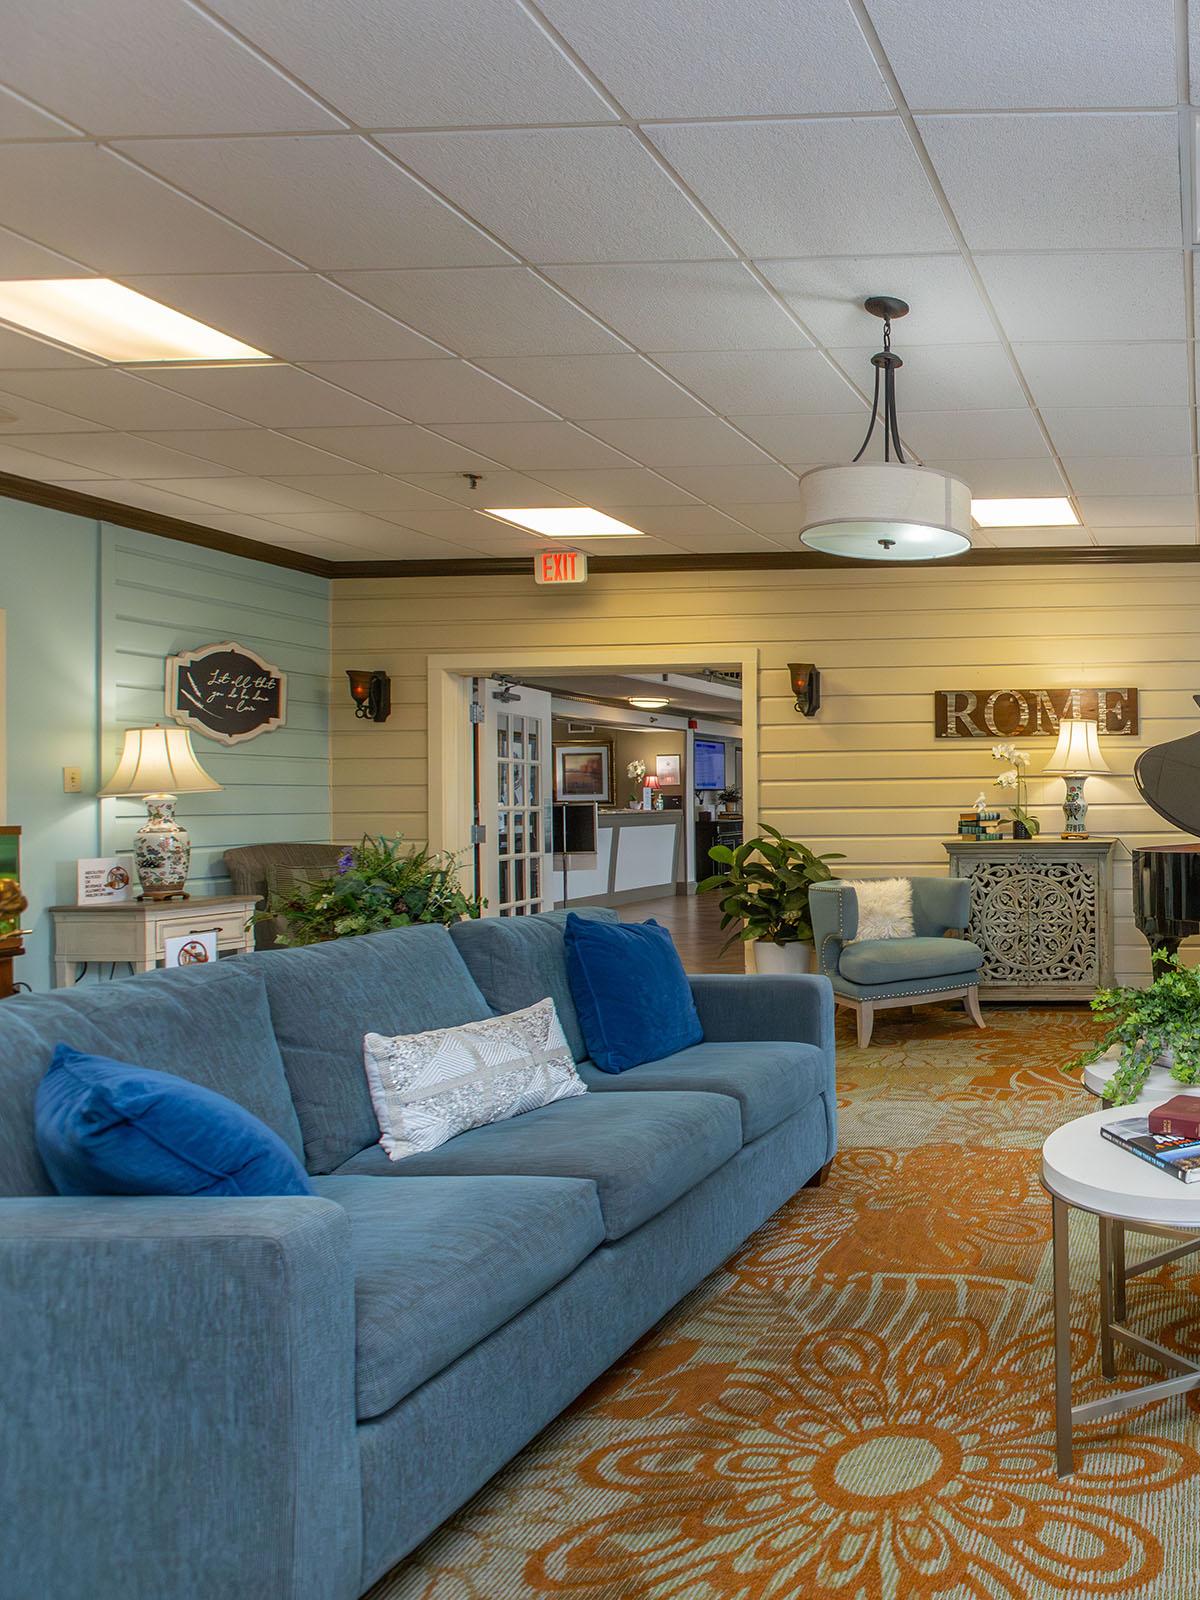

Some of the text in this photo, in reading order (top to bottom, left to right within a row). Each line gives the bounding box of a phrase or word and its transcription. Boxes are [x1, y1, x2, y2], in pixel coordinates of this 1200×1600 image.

[543, 553, 577, 581] EXIT
[207, 669, 276, 690] Let all that
[206, 687, 269, 703] you do be done
[941, 689, 1131, 736] ROME
